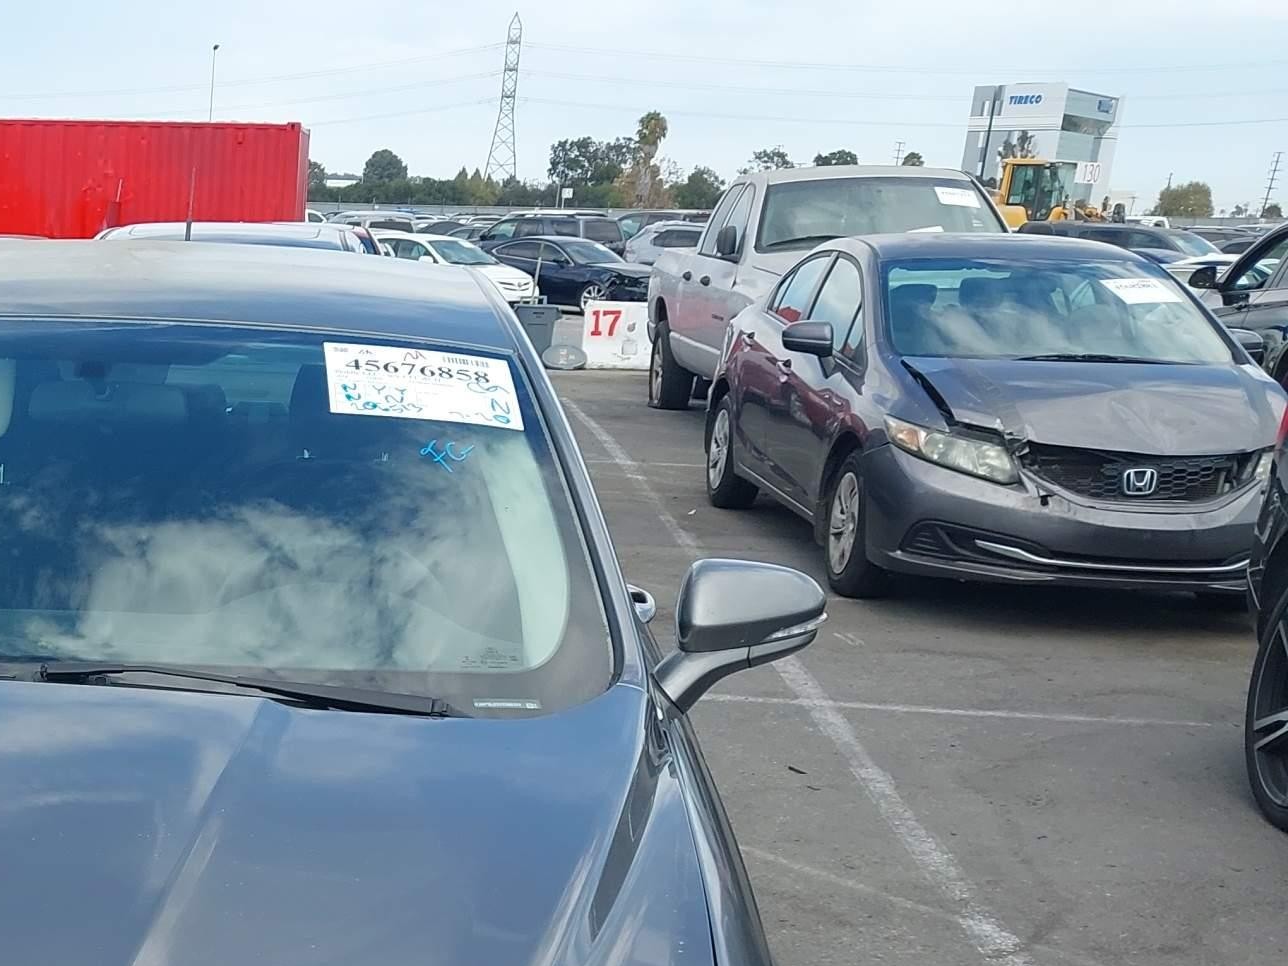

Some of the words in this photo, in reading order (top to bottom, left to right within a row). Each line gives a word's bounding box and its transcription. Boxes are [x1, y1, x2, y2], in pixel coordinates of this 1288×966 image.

[1009, 94, 1043, 105] TIRECO
[1082, 164, 1101, 183] 130
[590, 309, 622, 337] 17
[344, 358, 492, 384] 45676858
